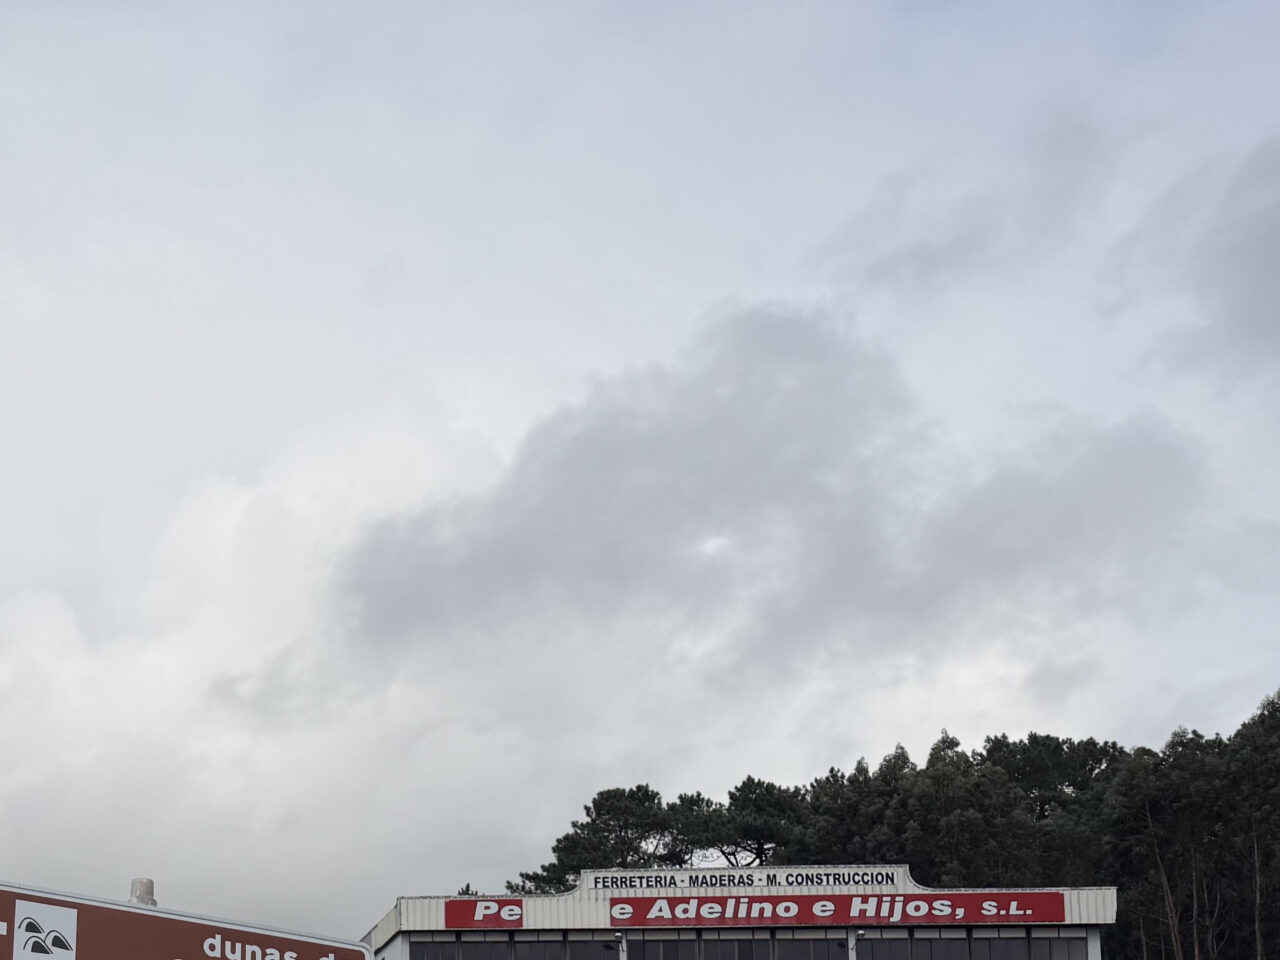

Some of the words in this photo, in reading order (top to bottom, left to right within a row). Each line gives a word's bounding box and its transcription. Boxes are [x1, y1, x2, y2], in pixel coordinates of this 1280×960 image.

[594, 874, 677, 889] FERRETERIA
[689, 873, 753, 887] MADERAS
[766, 873, 782, 886] M.
[786, 872, 895, 885] CONSTRUCCION
[646, 897, 799, 920] Adelino
[812, 900, 836, 917] e
[849, 896, 966, 922] Hijos,
